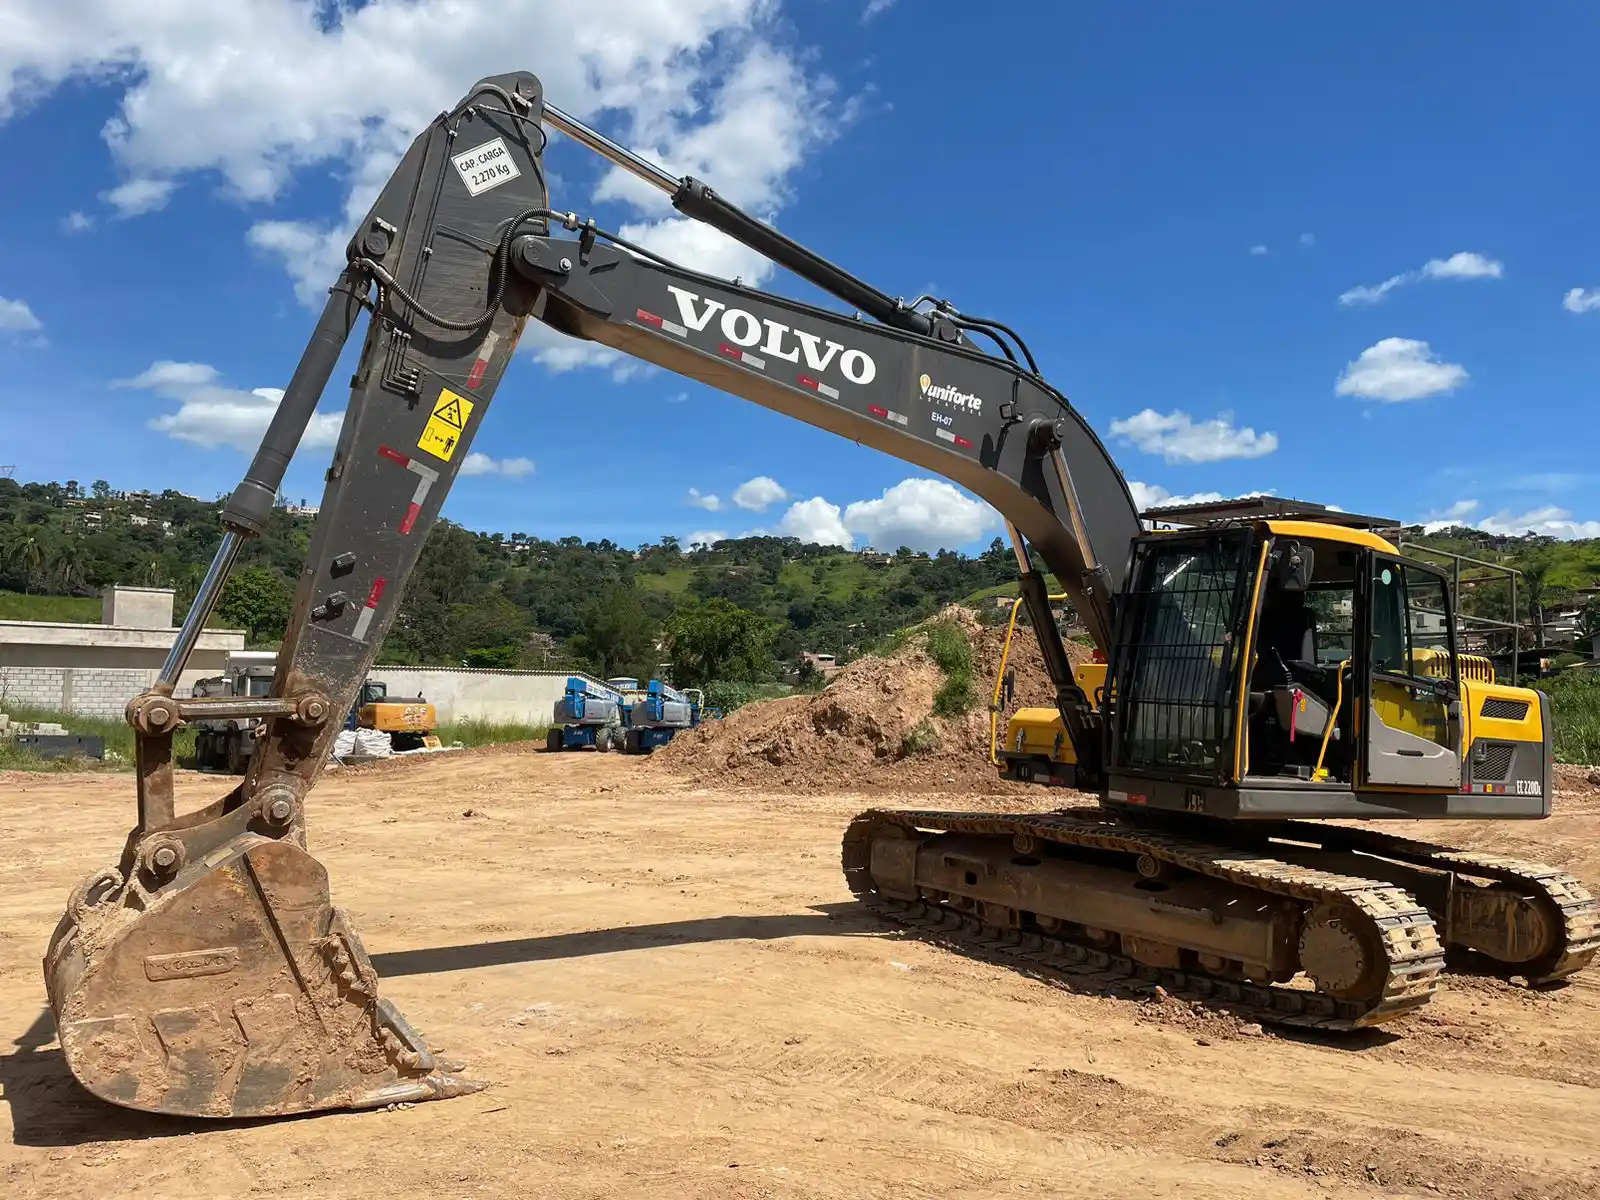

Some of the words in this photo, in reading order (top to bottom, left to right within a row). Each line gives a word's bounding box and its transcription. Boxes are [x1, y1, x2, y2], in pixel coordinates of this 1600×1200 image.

[459, 158, 479, 172] CAP.
[478, 146, 506, 164] CARGA
[472, 167, 496, 186] 2.270
[496, 164, 510, 176] Kg
[667, 284, 877, 385] VOLVO
[927, 384, 982, 410] uniforte
[931, 411, 953, 426] EH-07
